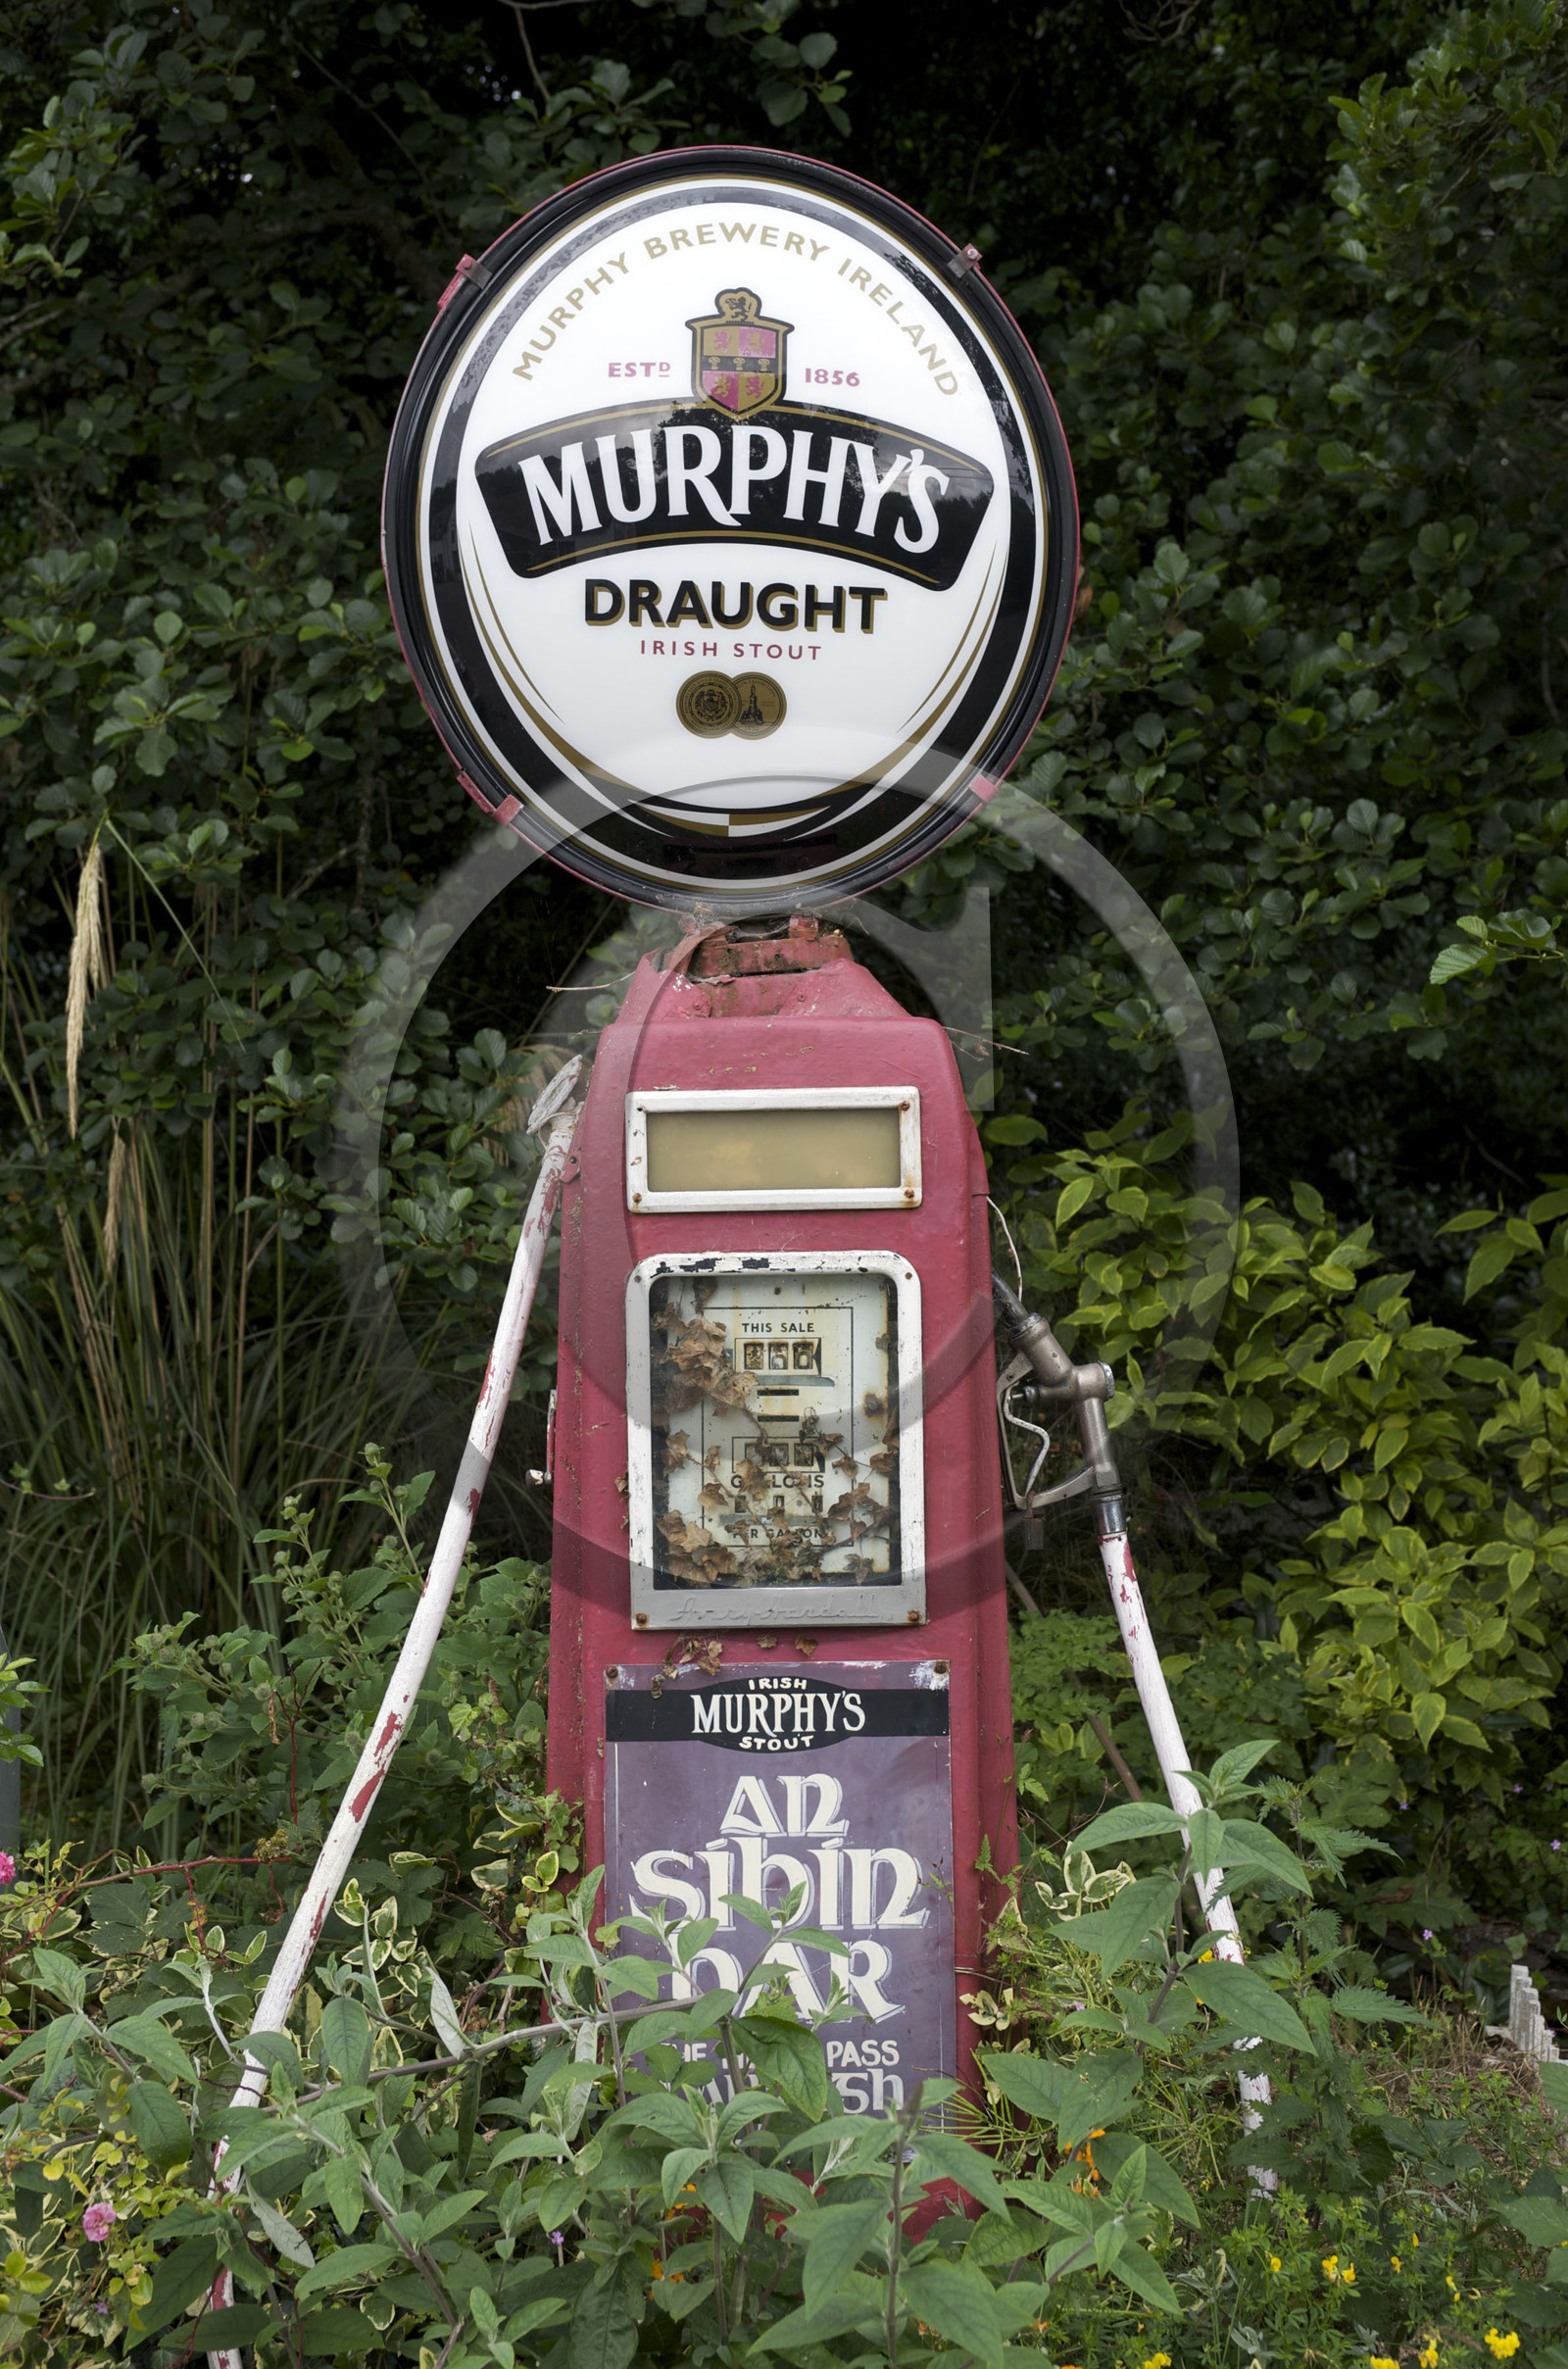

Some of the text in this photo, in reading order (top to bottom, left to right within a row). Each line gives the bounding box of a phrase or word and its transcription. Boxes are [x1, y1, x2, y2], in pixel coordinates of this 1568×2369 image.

[512, 222, 959, 397] MURPHY BREWERY IRELAND
[805, 368, 860, 387] 1856
[517, 423, 951, 555] MURPHY'S
[585, 578, 888, 634] DRAUGHT
[640, 639, 822, 662] IRISH STOUT
[742, 1323, 815, 1333] THIS SALE
[731, 1474, 825, 1489] GLOS
[748, 1677, 808, 1690] IRISH
[690, 1691, 866, 1738] MURPHY'S
[739, 1735, 814, 1751] STOUT
[826, 2040, 900, 2068] PASS
